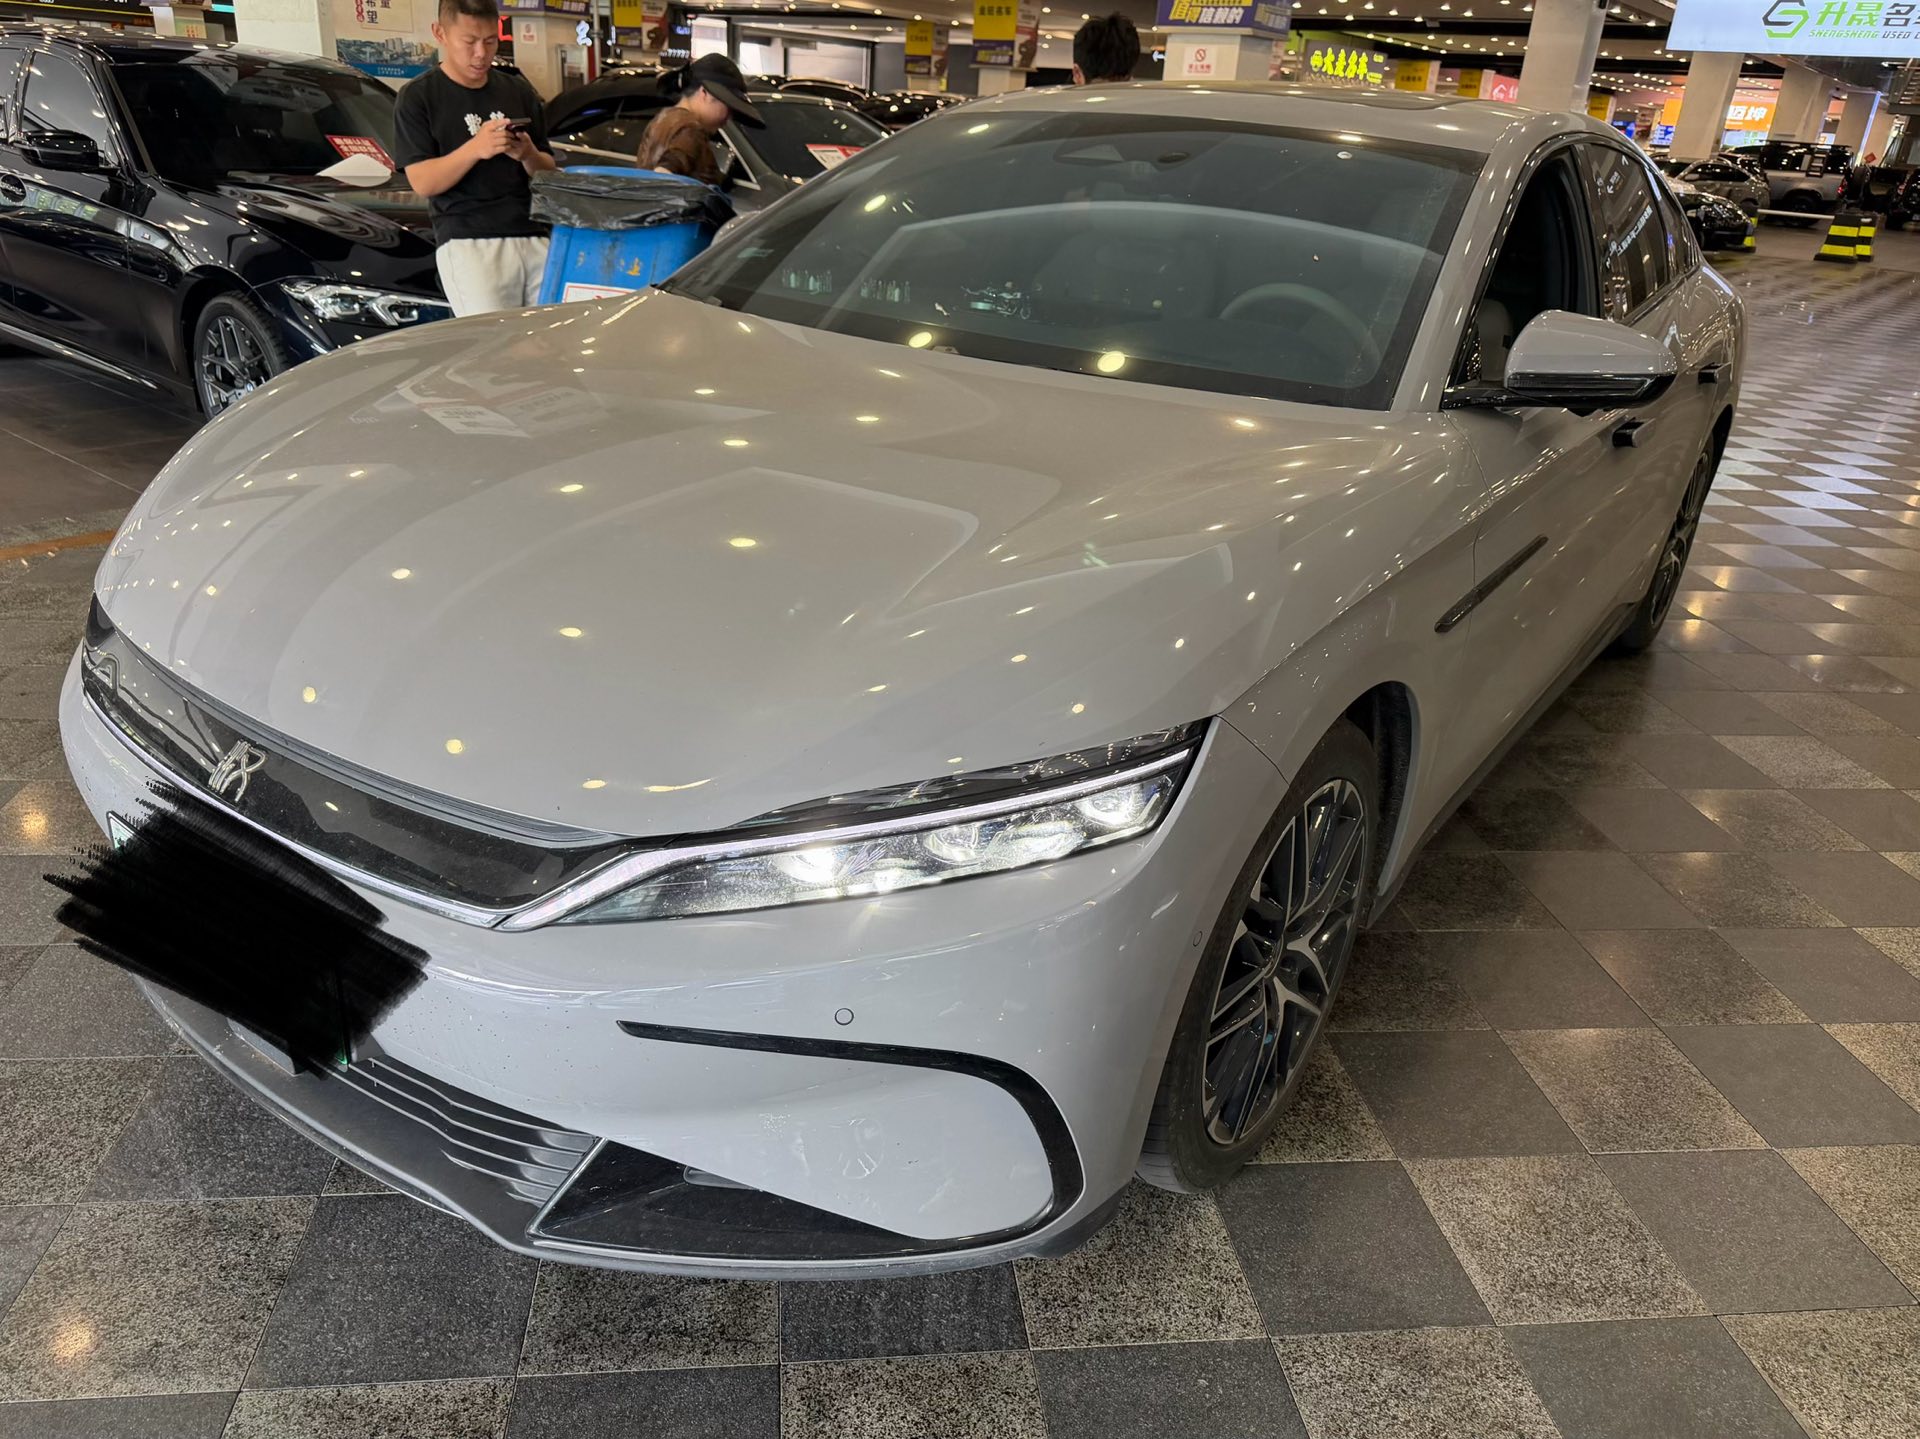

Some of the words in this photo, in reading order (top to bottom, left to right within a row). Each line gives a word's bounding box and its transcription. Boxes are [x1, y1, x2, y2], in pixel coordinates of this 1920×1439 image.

[1816, 1, 1920, 27] 升晟名
[1808, 29, 1879, 40] SHENGSHENG
[1881, 30, 1912, 40] USED
